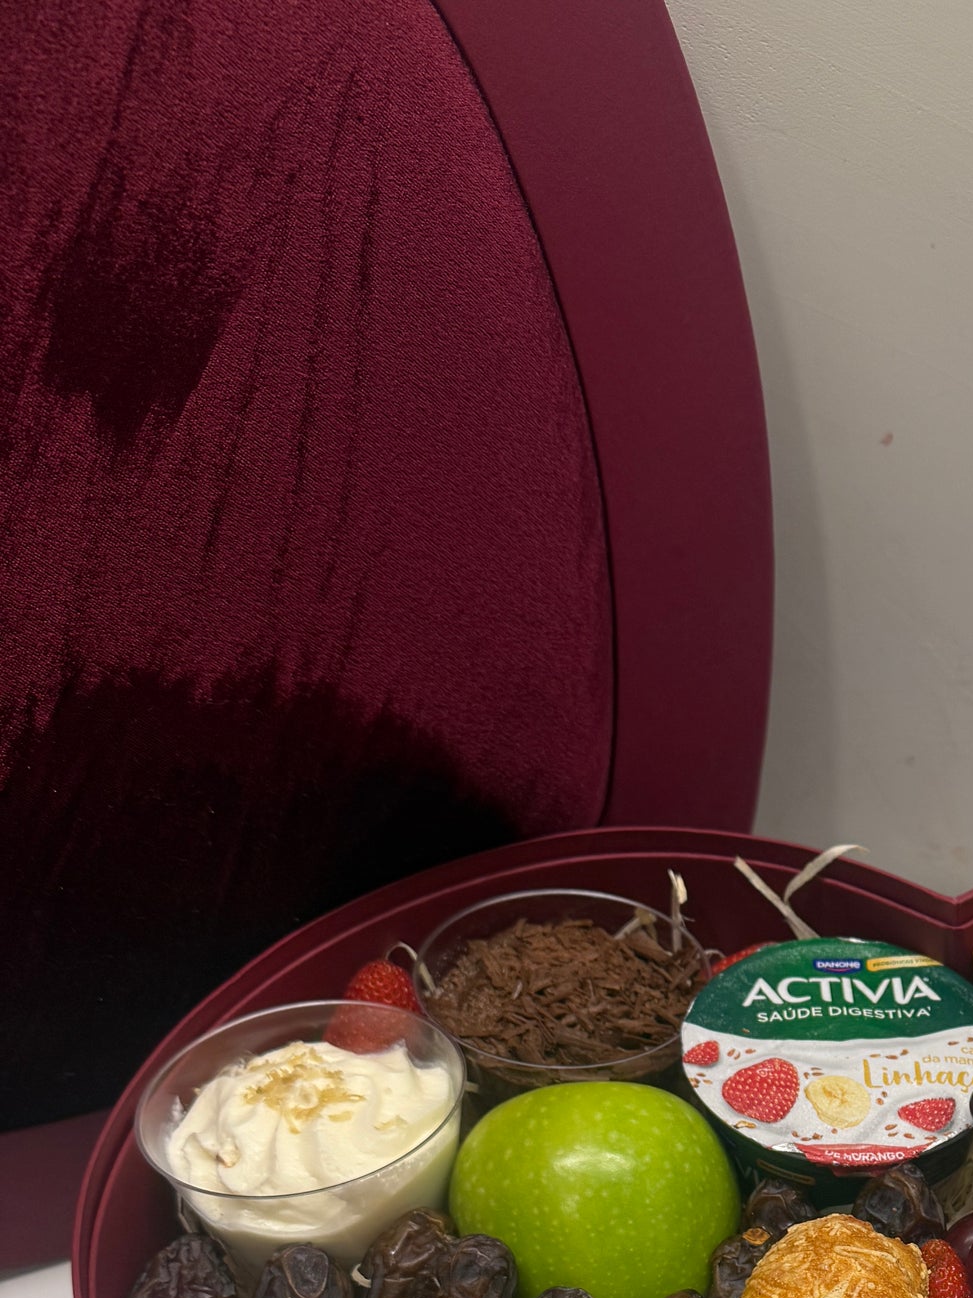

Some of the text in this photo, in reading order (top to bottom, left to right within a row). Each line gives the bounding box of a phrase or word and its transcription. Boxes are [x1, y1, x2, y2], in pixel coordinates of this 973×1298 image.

[816, 960, 860, 969] DANONE
[741, 975, 942, 1007] ACTIVIA
[757, 1006, 824, 1023] SAÚDE
[921, 1054, 940, 1064] da
